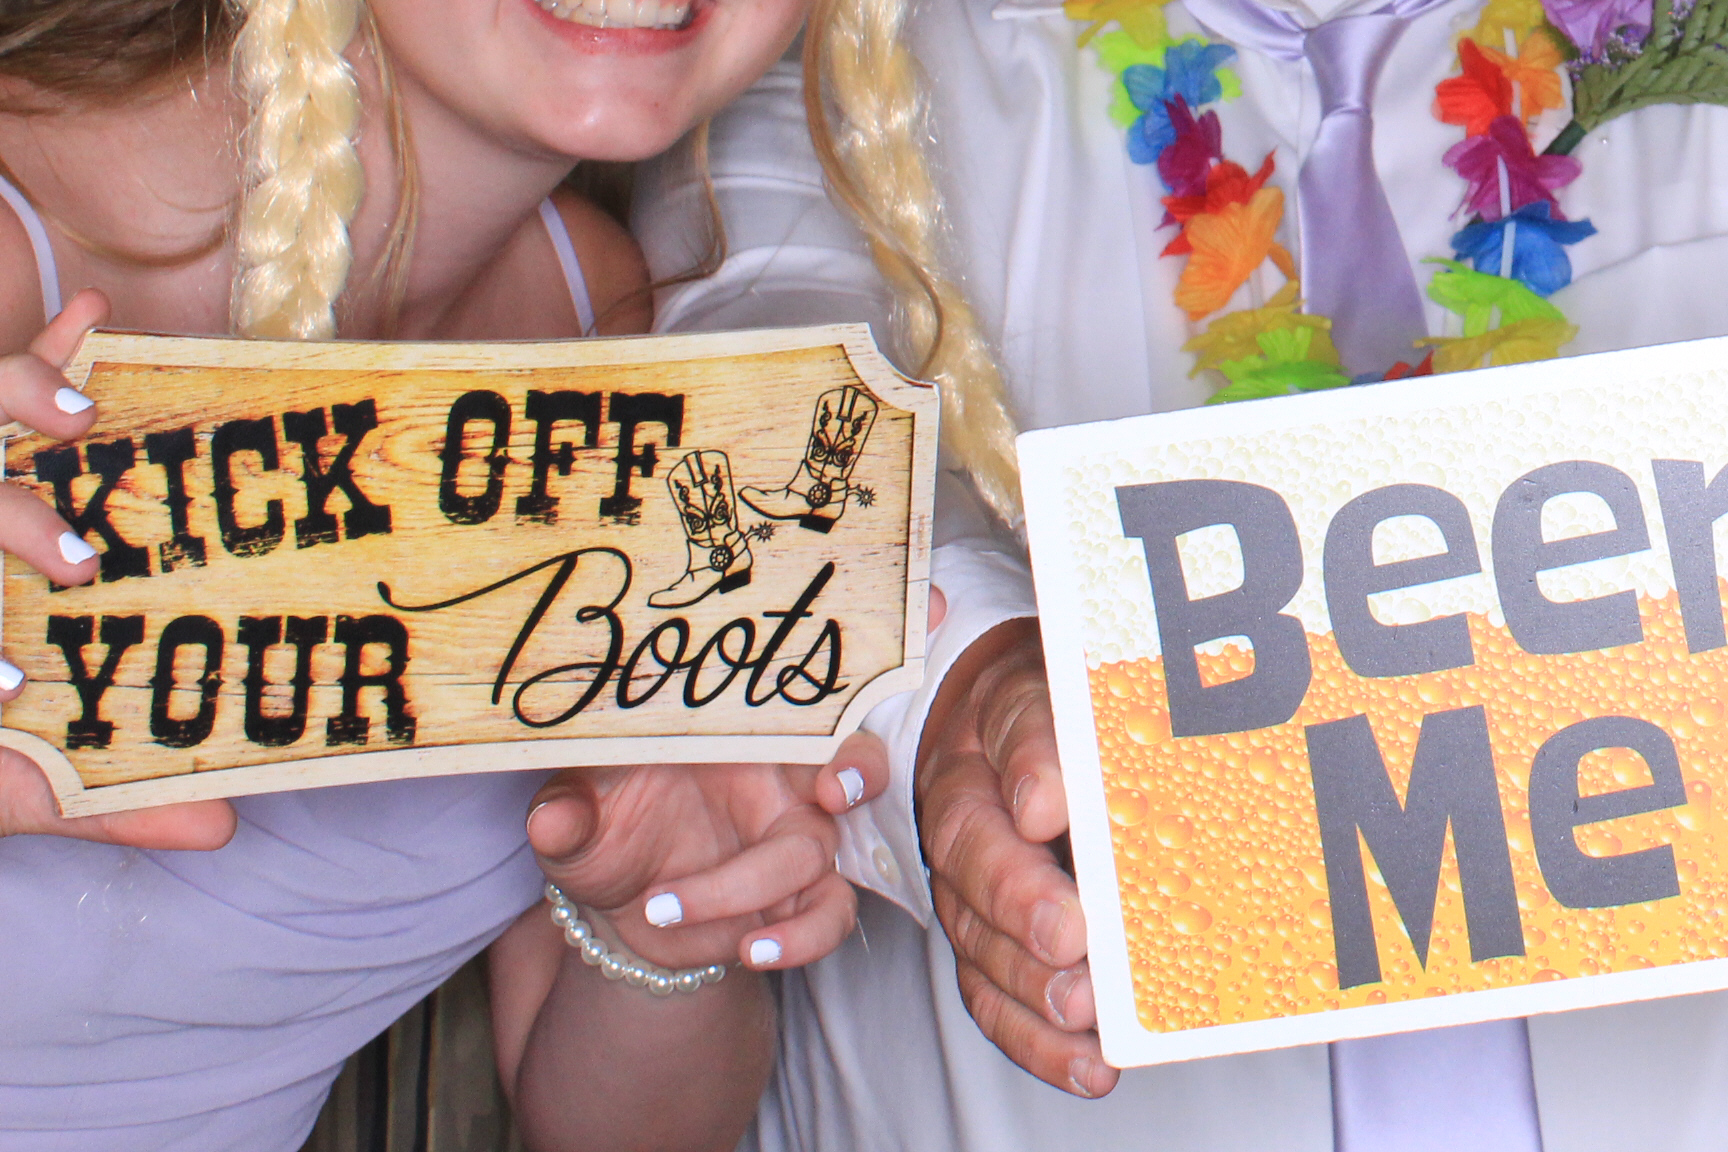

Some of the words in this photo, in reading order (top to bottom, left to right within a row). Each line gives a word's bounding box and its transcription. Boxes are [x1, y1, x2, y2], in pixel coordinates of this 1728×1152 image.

[34, 398, 393, 593] KICK
[437, 389, 687, 527] OFF
[46, 614, 417, 750] YOUR
[377, 546, 848, 729] Boots
[1303, 703, 1689, 991] Me
